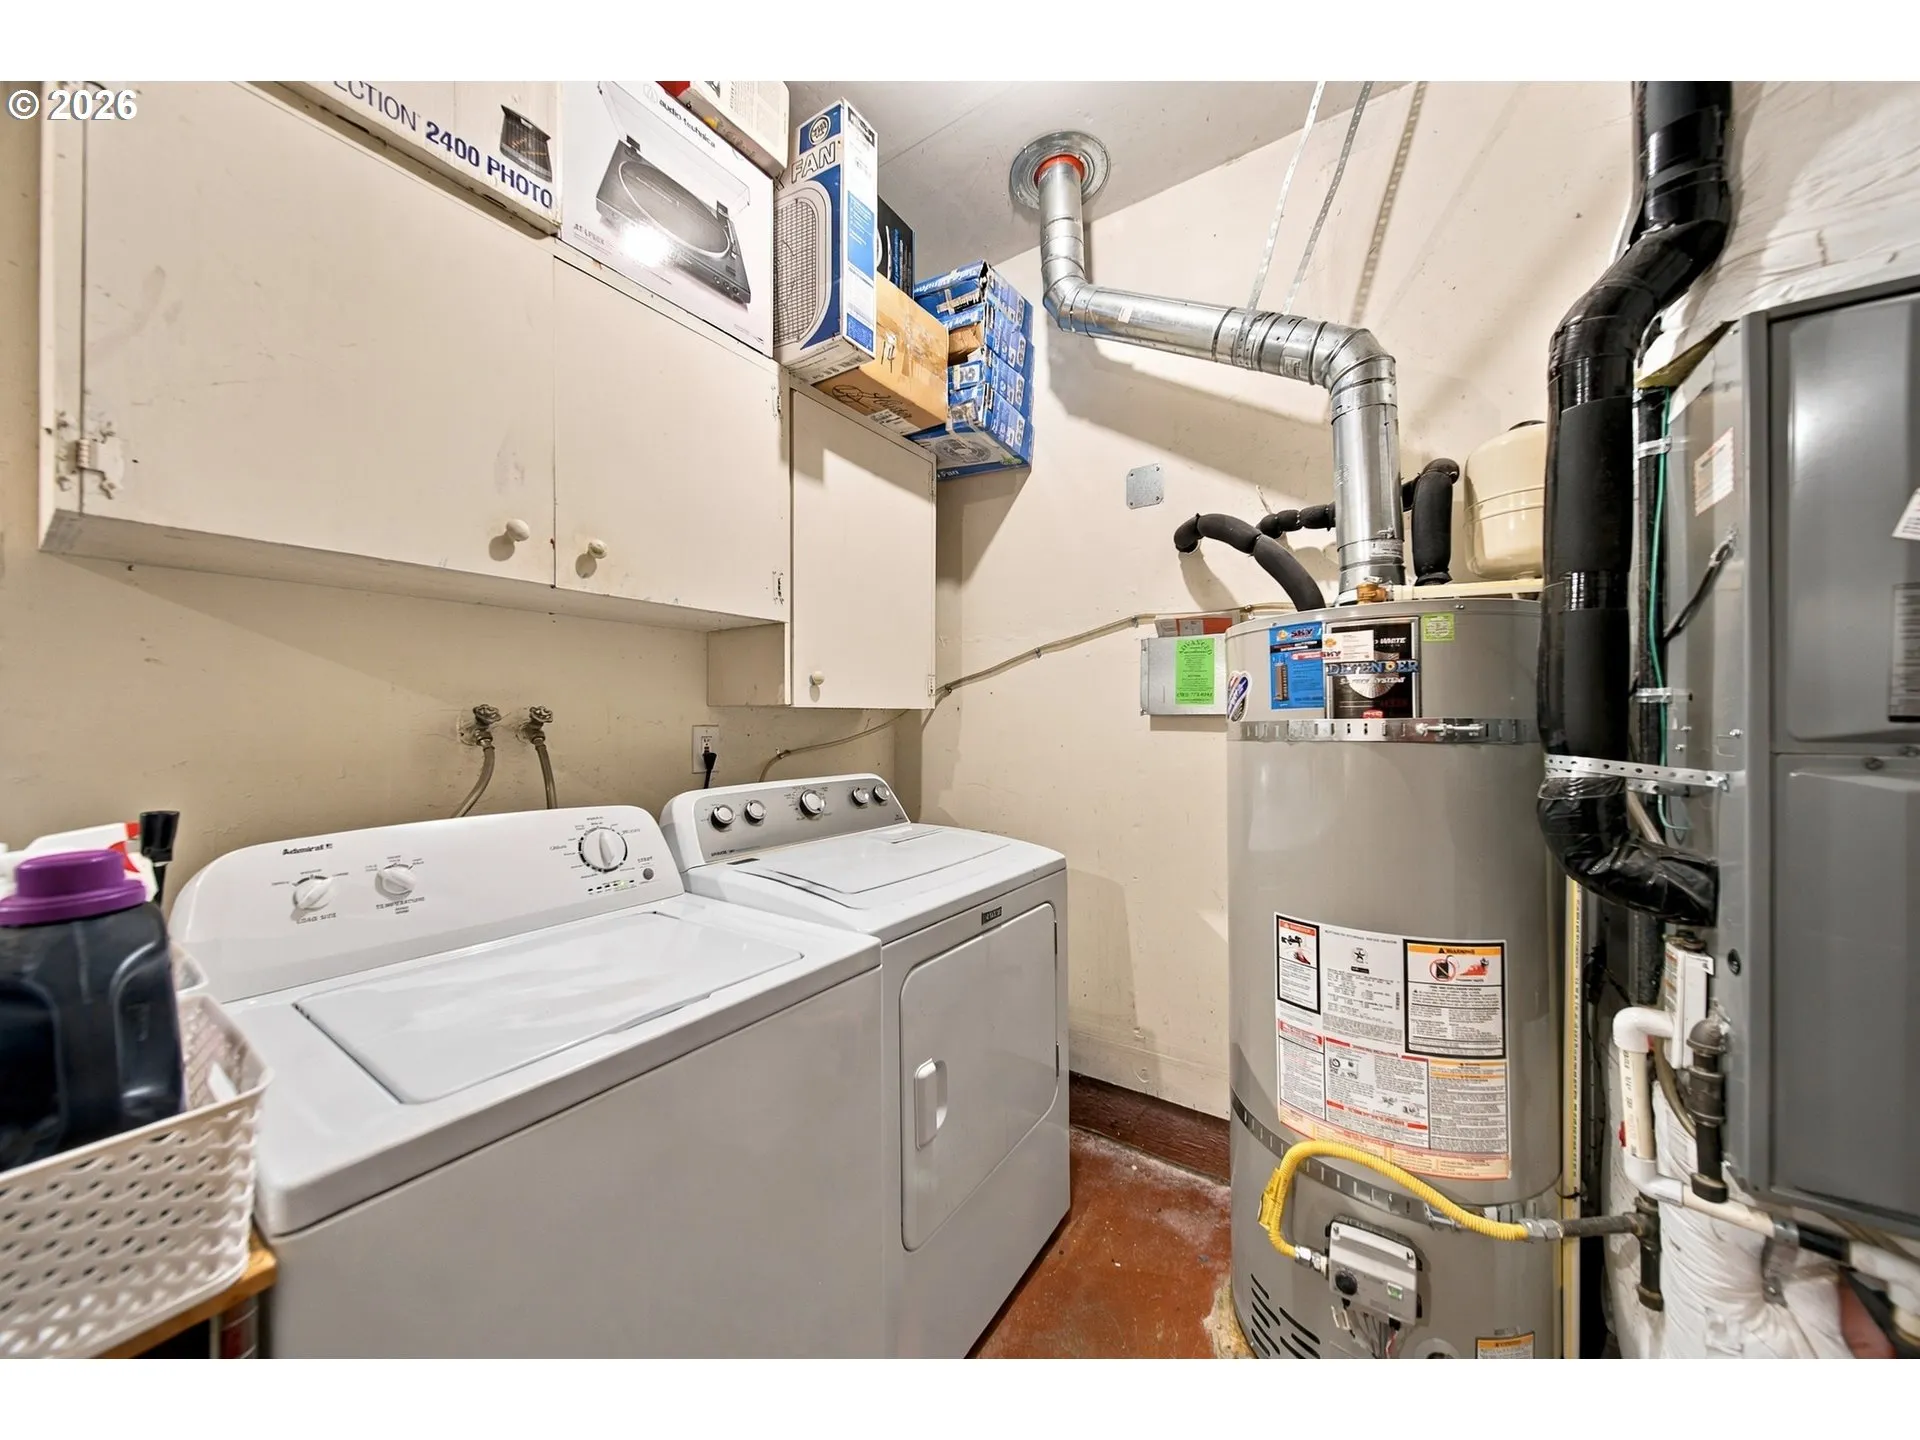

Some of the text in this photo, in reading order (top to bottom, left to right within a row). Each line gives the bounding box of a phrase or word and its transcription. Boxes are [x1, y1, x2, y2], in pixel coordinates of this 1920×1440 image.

[425, 121, 480, 168] 2400
[486, 155, 553, 209] PHOTO
[791, 140, 836, 184] FAN
[1327, 660, 1419, 676] DEFENDER
